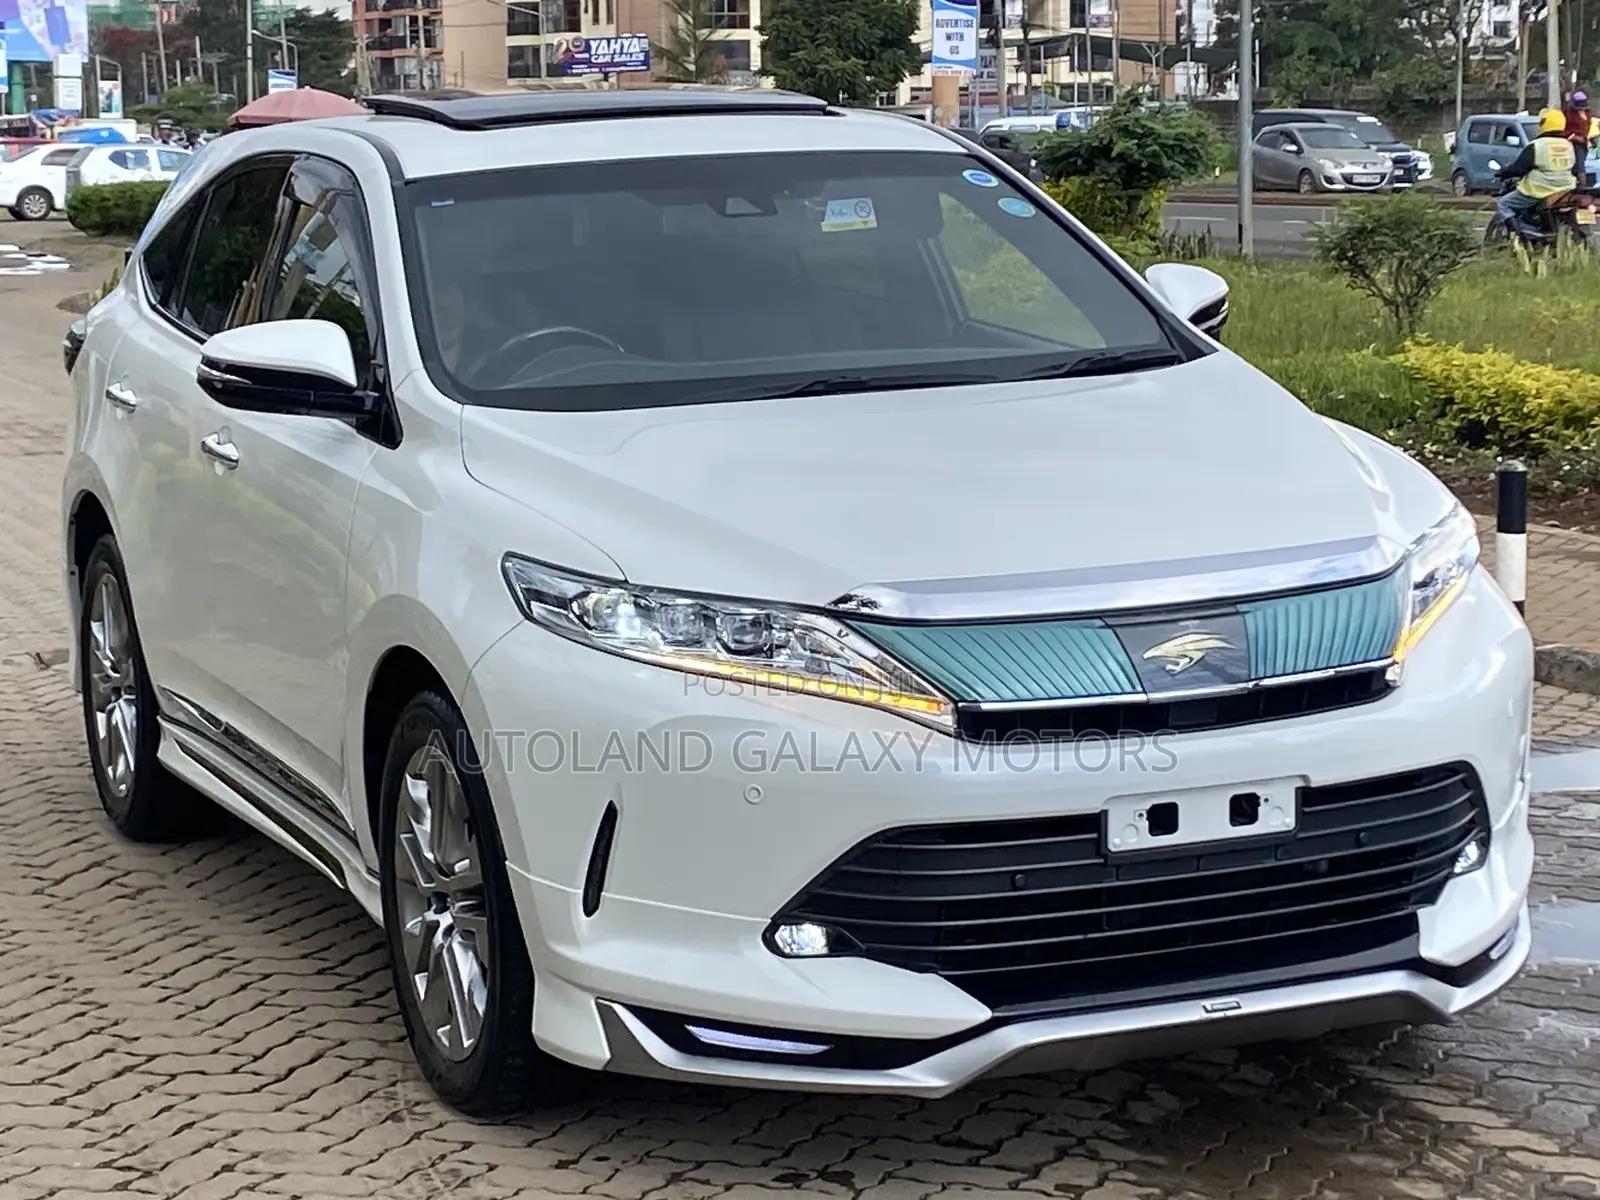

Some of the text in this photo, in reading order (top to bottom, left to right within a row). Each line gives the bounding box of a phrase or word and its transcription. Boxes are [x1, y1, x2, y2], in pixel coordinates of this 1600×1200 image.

[936, 19, 974, 28] ADVERTISE
[945, 32, 964, 41] WITH
[589, 37, 640, 54] YAHYA
[950, 46, 959, 55] US
[591, 54, 611, 62] CAR
[613, 52, 645, 62] SALES
